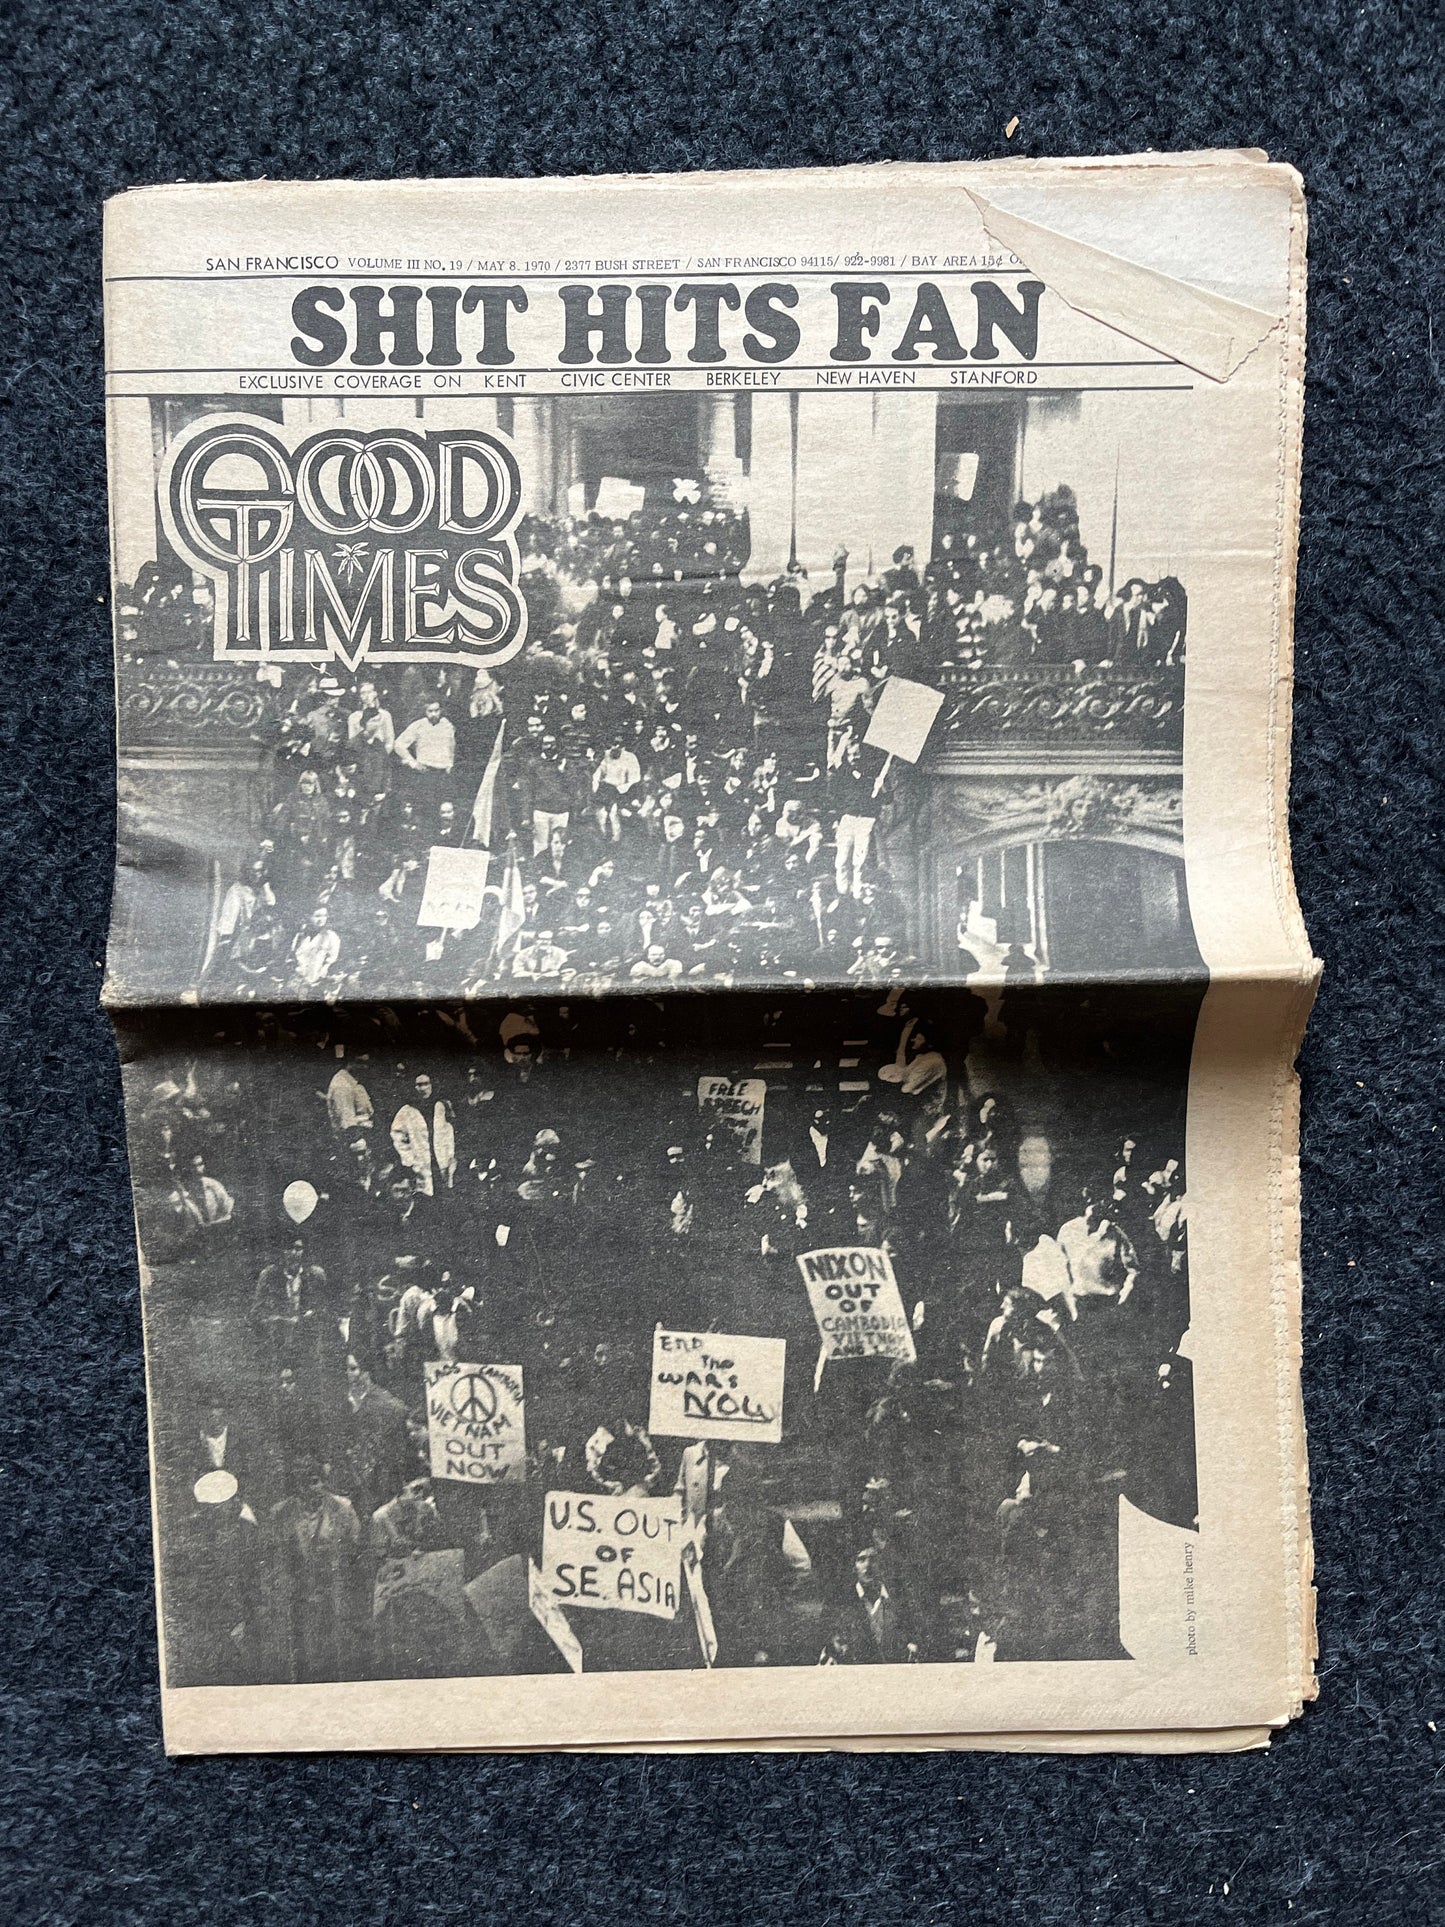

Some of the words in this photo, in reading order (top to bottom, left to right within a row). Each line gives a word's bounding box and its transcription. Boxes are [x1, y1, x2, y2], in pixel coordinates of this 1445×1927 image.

[206, 257, 240, 271] SAN
[246, 256, 339, 271] FRANCISCO
[348, 257, 402, 269] VOLUME
[407, 259, 420, 270] III
[424, 259, 446, 271] NO.
[450, 260, 463, 271] 19
[478, 261, 505, 271] MAY
[524, 260, 551, 272] 1970
[565, 260, 591, 271] 2377
[595, 260, 628, 271] BUSH
[632, 259, 680, 270] STREET
[697, 257, 721, 268] SAN
[725, 256, 797, 268] FRANCISCO
[844, 253, 896, 267] 922-9981
[911, 255, 938, 266] BAY
[943, 255, 978, 266] AREA
[290, 285, 529, 367] SHIT
[558, 283, 800, 365] HITS
[829, 280, 1046, 361] FAN
[239, 375, 323, 390] EXCLUSIVE
[334, 374, 422, 389] COVERAGE
[433, 374, 462, 388] ON
[484, 374, 528, 388] KENT
[560, 373, 605, 388] CIVIC
[611, 372, 672, 387] CENTER
[706, 371, 781, 387] BERKELEY
[816, 371, 853, 386] NEW
[858, 370, 916, 385] HAVEN
[950, 370, 1038, 385] STANFORD
[176, 428, 519, 564] GOOD
[196, 498, 514, 648] TIMES
[709, 1082, 748, 1097] FREE
[804, 1252, 888, 1282] NIXON
[825, 1283, 881, 1300] OUT
[446, 1439, 505, 1460] OUT
[446, 1460, 511, 1479] NOW
[550, 1500, 602, 1534] U.S.
[614, 1509, 678, 1542] OUT
[595, 1545, 635, 1564] OF
[1183, 1542, 1195, 1575] henry
[552, 1563, 608, 1600] S.E.
[617, 1567, 676, 1610] ASIA
[1183, 1577, 1194, 1605] mike
[1185, 1609, 1197, 1622] by
[1186, 1625, 1198, 1656] photo
